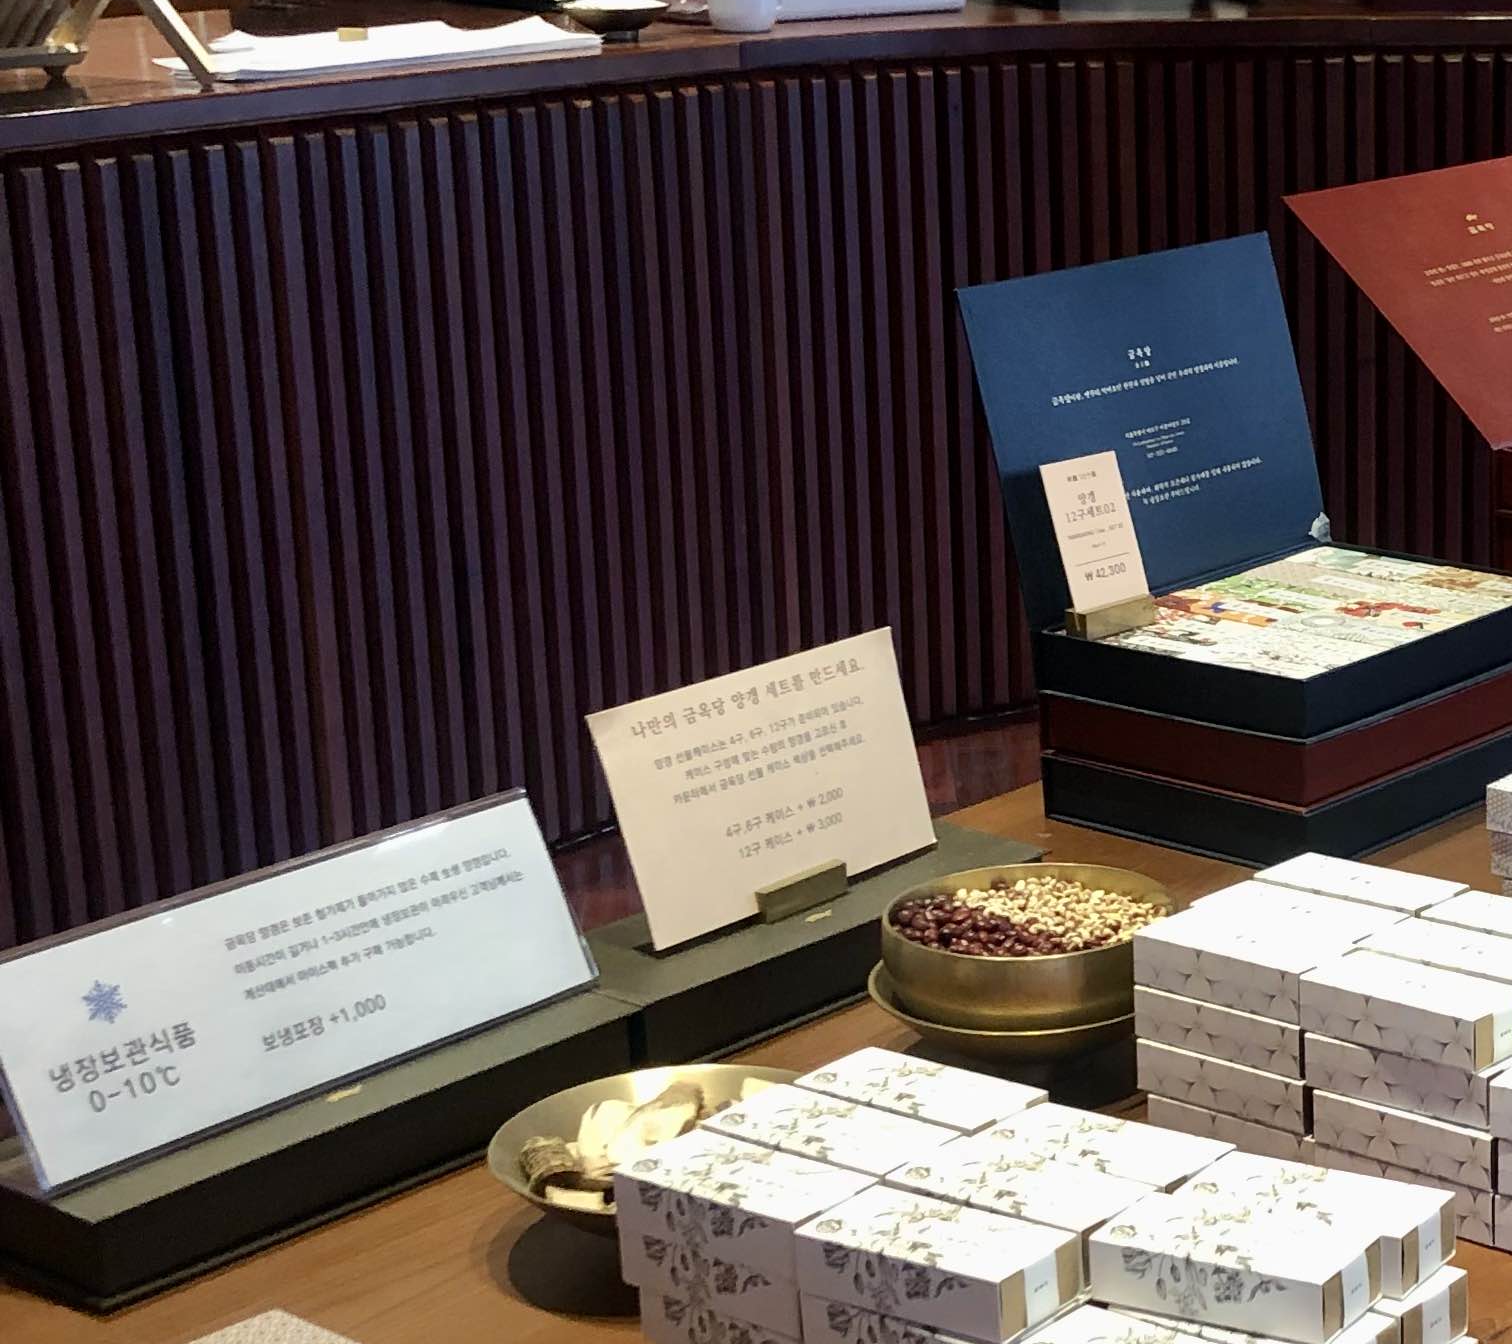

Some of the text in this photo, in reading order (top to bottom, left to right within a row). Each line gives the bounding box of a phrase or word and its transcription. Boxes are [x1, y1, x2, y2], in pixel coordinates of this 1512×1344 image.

[632, 657, 865, 739] 나만의 금옥당 양갱 세트를 만드세요.
[765, 804, 797, 825] 케이스
[764, 829, 794, 850] 케이스
[261, 1016, 325, 1053] 보냉포장
[48, 1022, 197, 1094] 냉장보관식품
